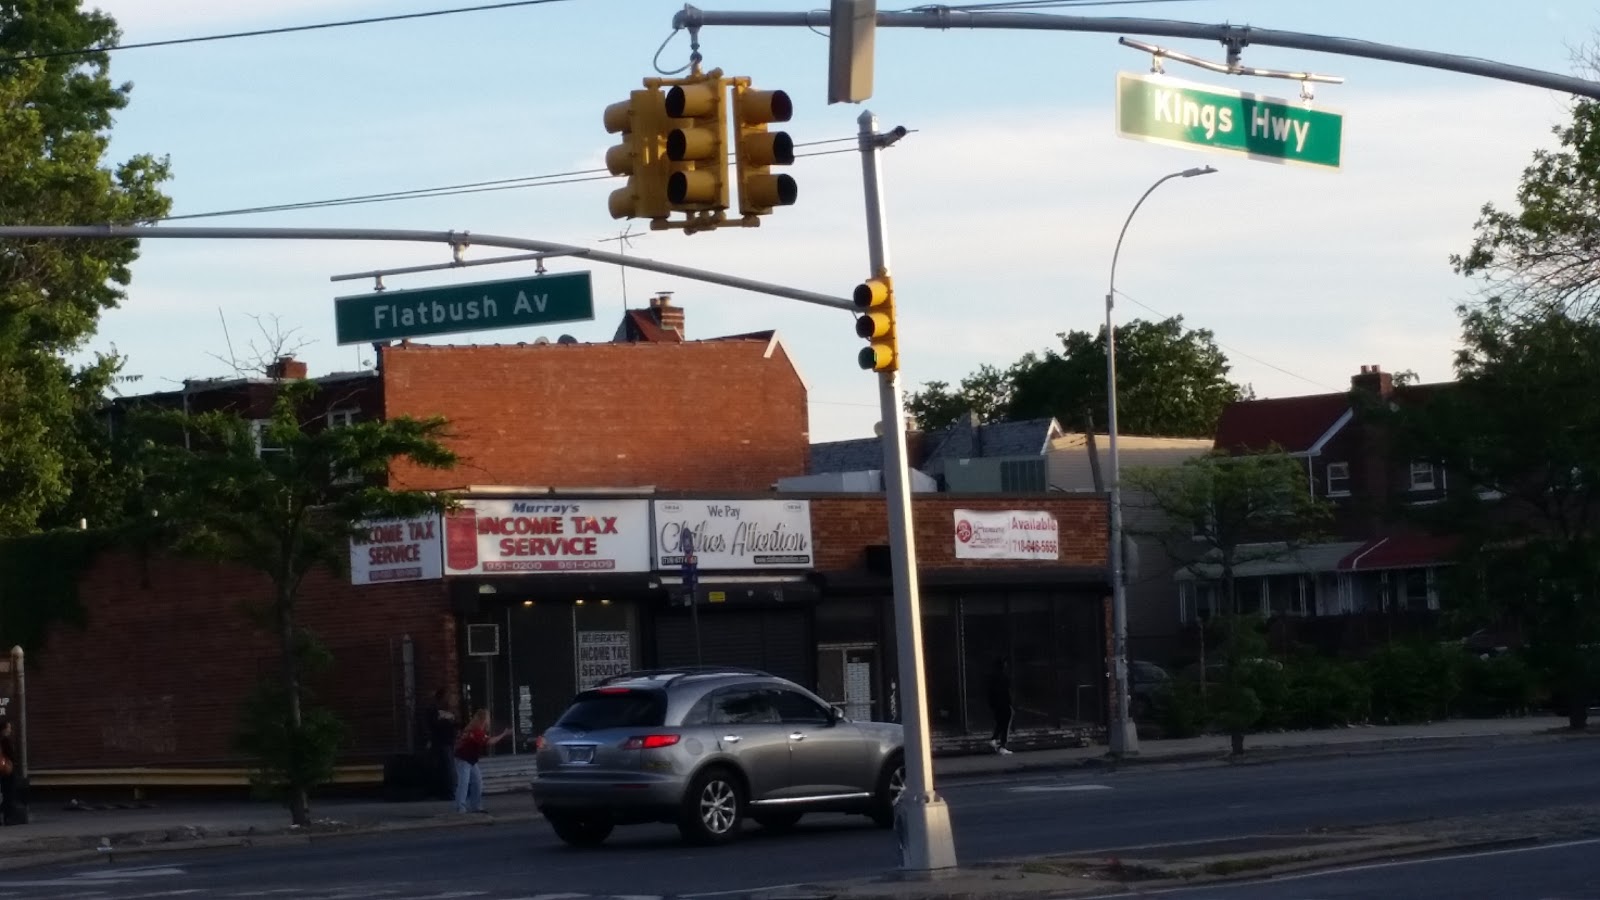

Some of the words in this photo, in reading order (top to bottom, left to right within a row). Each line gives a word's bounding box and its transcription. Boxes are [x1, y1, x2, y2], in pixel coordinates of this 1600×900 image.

[1154, 88, 1233, 140] Kings
[1251, 106, 1310, 153] Hwy
[374, 294, 498, 330] Flatbush
[513, 289, 549, 315] Av
[512, 501, 580, 515] Murray's
[707, 505, 723, 517] We
[725, 505, 740, 520] Pay
[408, 521, 435, 541] TAX
[477, 516, 563, 535] INCOME
[570, 516, 618, 535] TAX
[1011, 517, 1057, 531] Available
[500, 537, 597, 556] SERVICE
[731, 520, 807, 556] Attention
[369, 543, 420, 566] SERVICE
[486, 561, 542, 570] 951-0200
